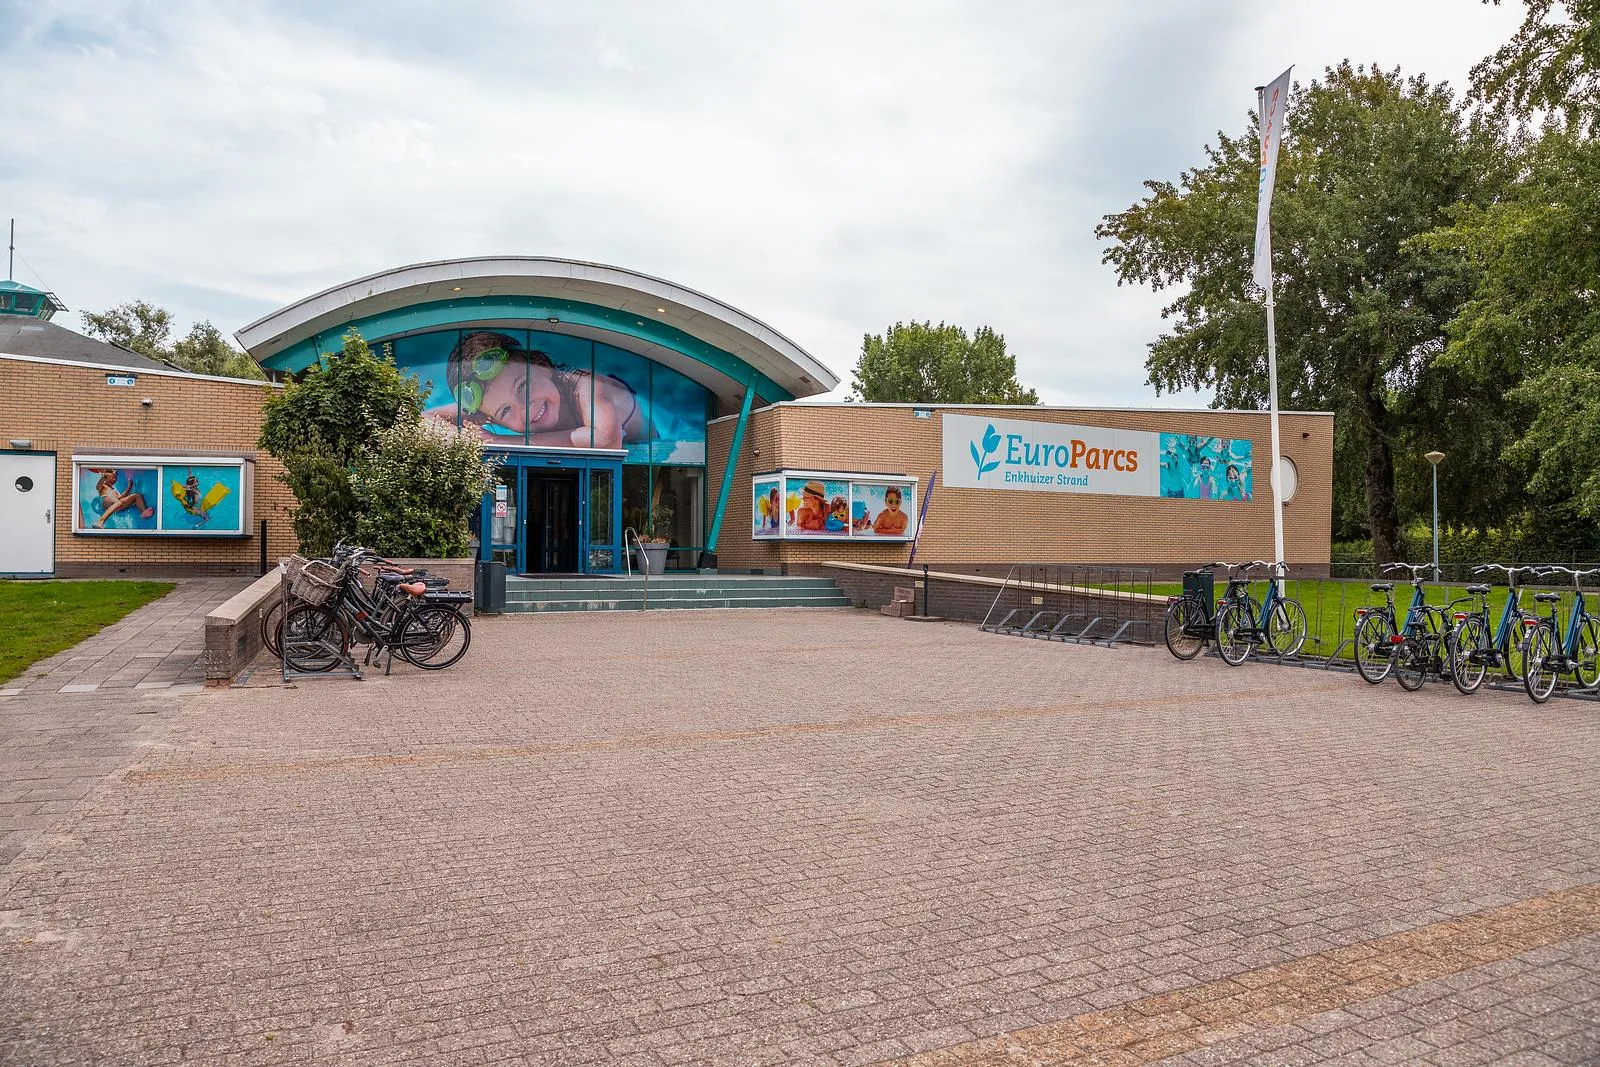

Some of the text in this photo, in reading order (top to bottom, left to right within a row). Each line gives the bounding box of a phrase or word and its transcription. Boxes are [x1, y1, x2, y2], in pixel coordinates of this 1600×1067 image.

[1005, 434, 1138, 473] EuroParcs
[1005, 471, 1089, 487] Enkhuizer Strand
